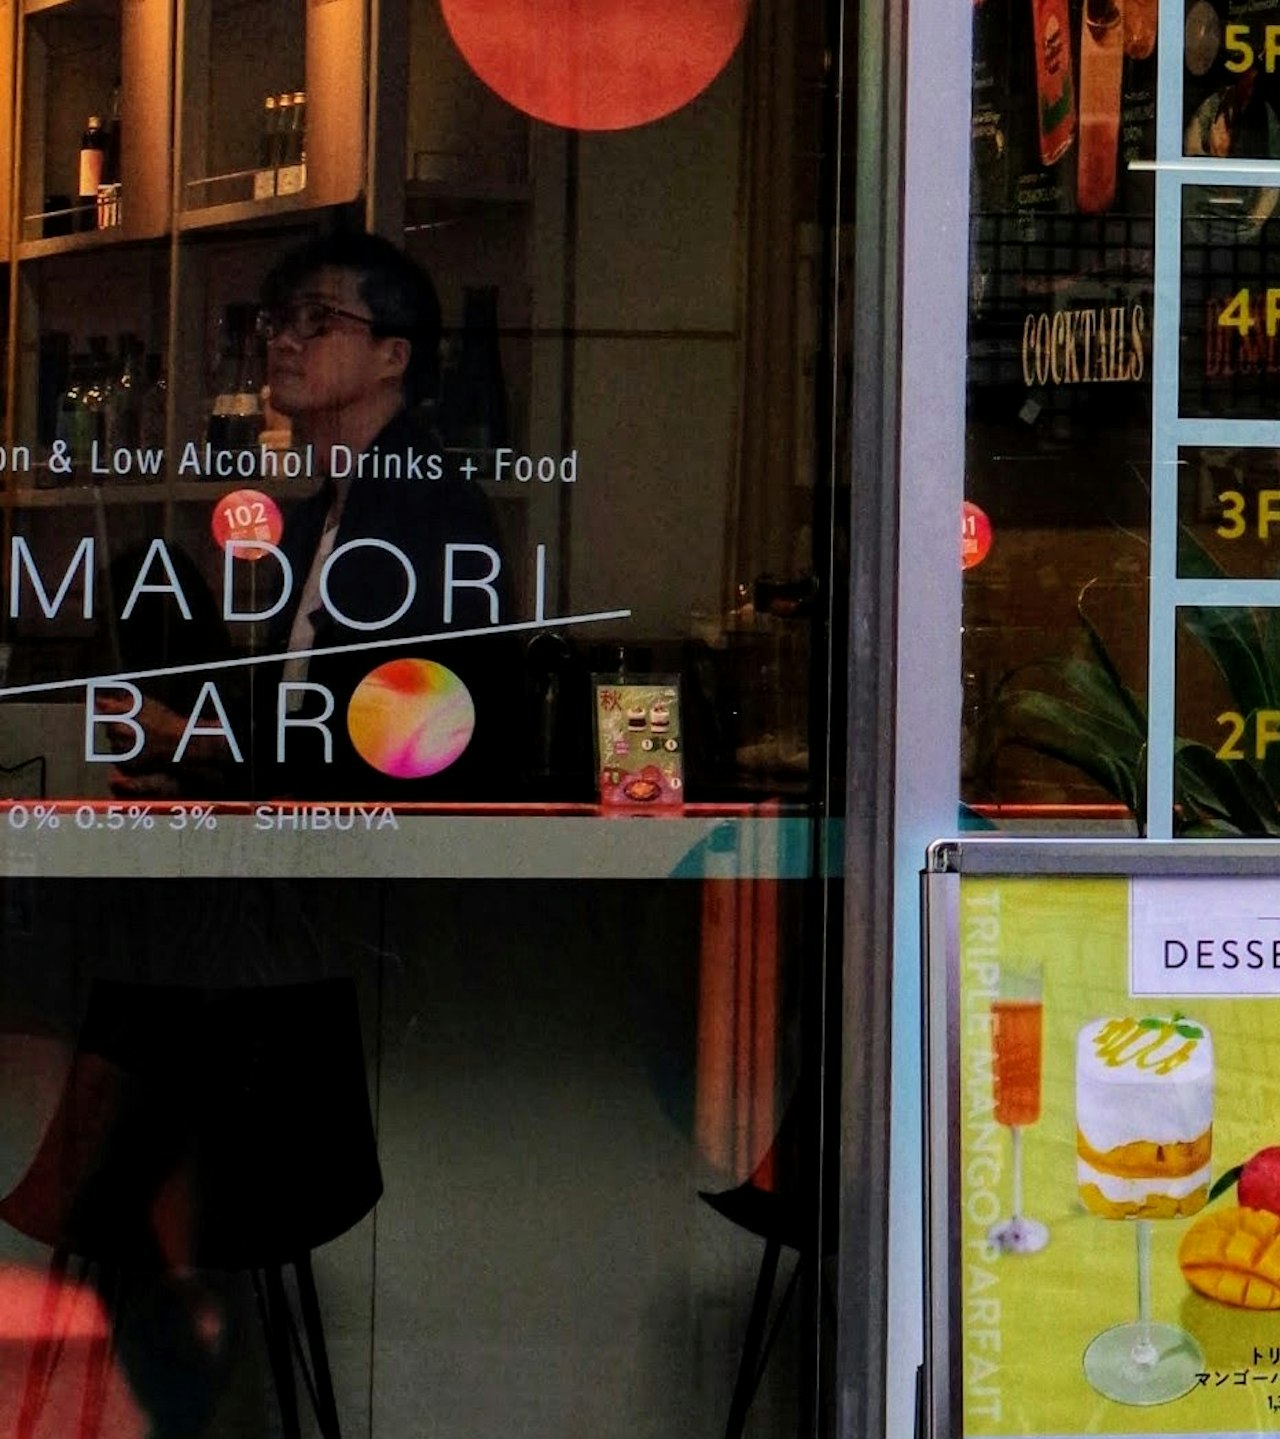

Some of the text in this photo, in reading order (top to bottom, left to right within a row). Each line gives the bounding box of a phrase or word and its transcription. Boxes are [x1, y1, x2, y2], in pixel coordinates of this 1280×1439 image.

[1023, 303, 1145, 387] COCKTAILS
[49, 443, 73, 474] &
[91, 440, 163, 476] Low
[179, 443, 313, 479] Alcohol
[330, 444, 443, 481] Drinks
[494, 448, 578, 483] Food
[224, 502, 267, 529] 102
[85, 681, 335, 764] BAR
[9, 805, 399, 830] 0% 0.5% 3% SHIBUYA
